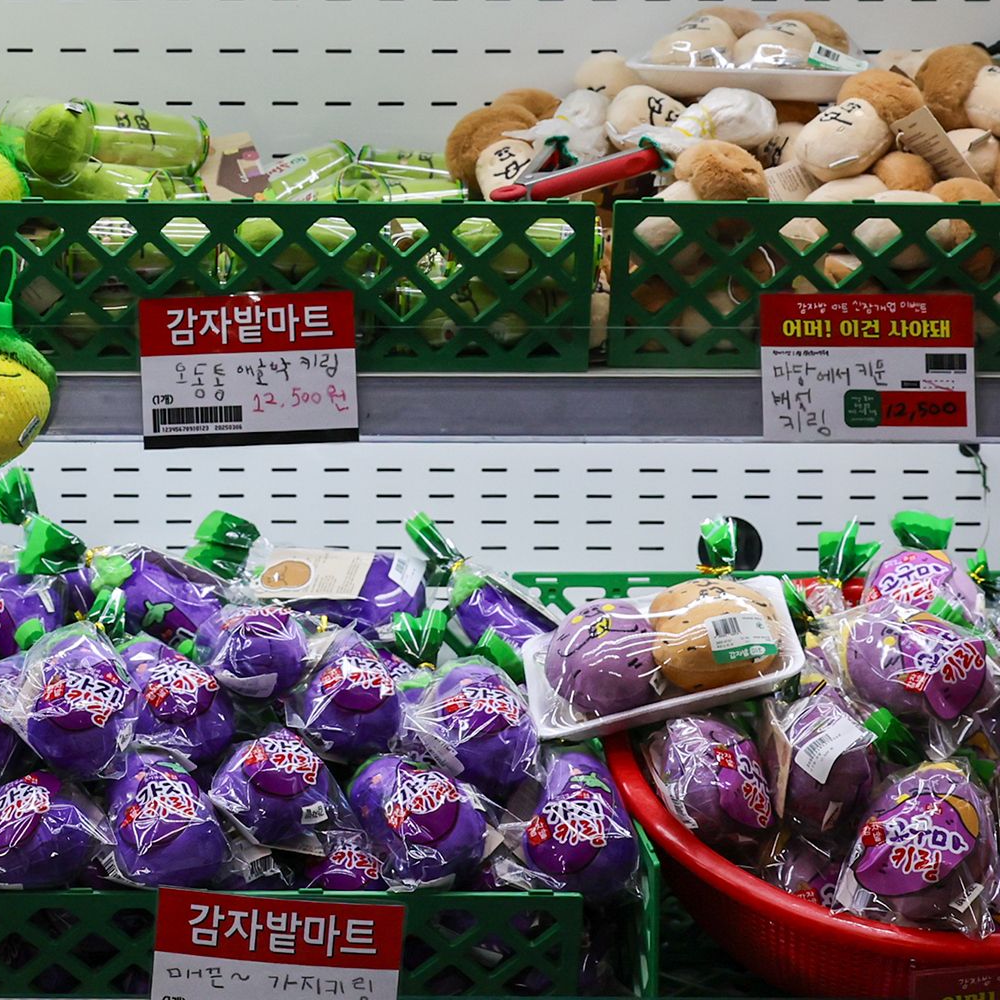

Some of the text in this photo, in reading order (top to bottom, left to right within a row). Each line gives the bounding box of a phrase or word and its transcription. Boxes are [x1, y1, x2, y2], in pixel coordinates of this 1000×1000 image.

[166, 303, 334, 347] 감자밭마트
[782, 318, 951, 339] 어머! 이건 사야돼
[175, 353, 339, 401] 오동통 애호박 키링
[772, 358, 889, 387] 마당에서 키운
[778, 410, 832, 438] 키링
[879, 564, 949, 595] 고구마
[940, 641, 985, 684] 키링
[66, 672, 126, 706] 가지
[271, 753, 320, 785] 키링
[137, 780, 193, 804] 가지
[553, 820, 608, 848] 키링
[885, 814, 970, 855] 고구마
[330, 848, 379, 880] 키링
[890, 846, 942, 883] 키링
[187, 903, 377, 958] 감자밭마트
